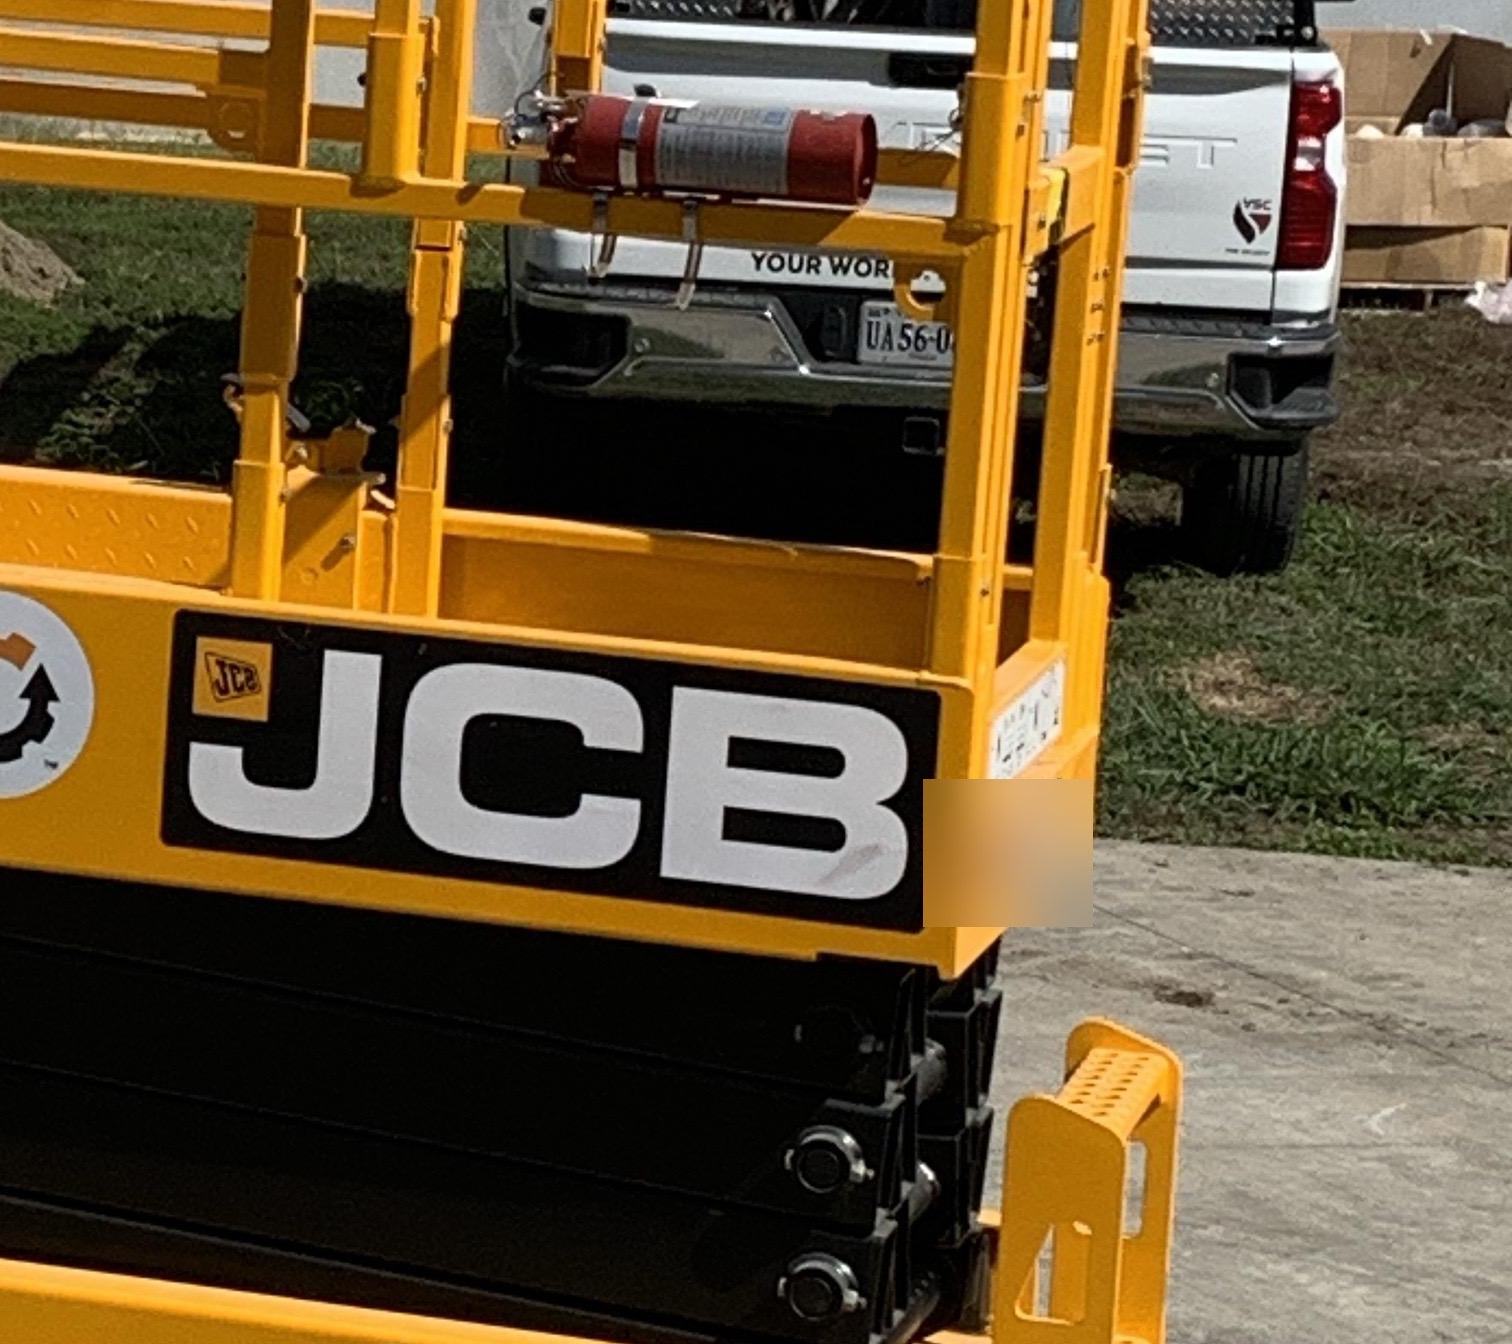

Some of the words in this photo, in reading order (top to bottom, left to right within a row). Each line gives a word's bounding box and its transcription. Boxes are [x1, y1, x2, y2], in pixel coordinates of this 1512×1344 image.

[751, 253, 822, 275] YOUR
[828, 256, 890, 279] WOR
[214, 657, 259, 697] JCB
[188, 649, 908, 899] JCB
